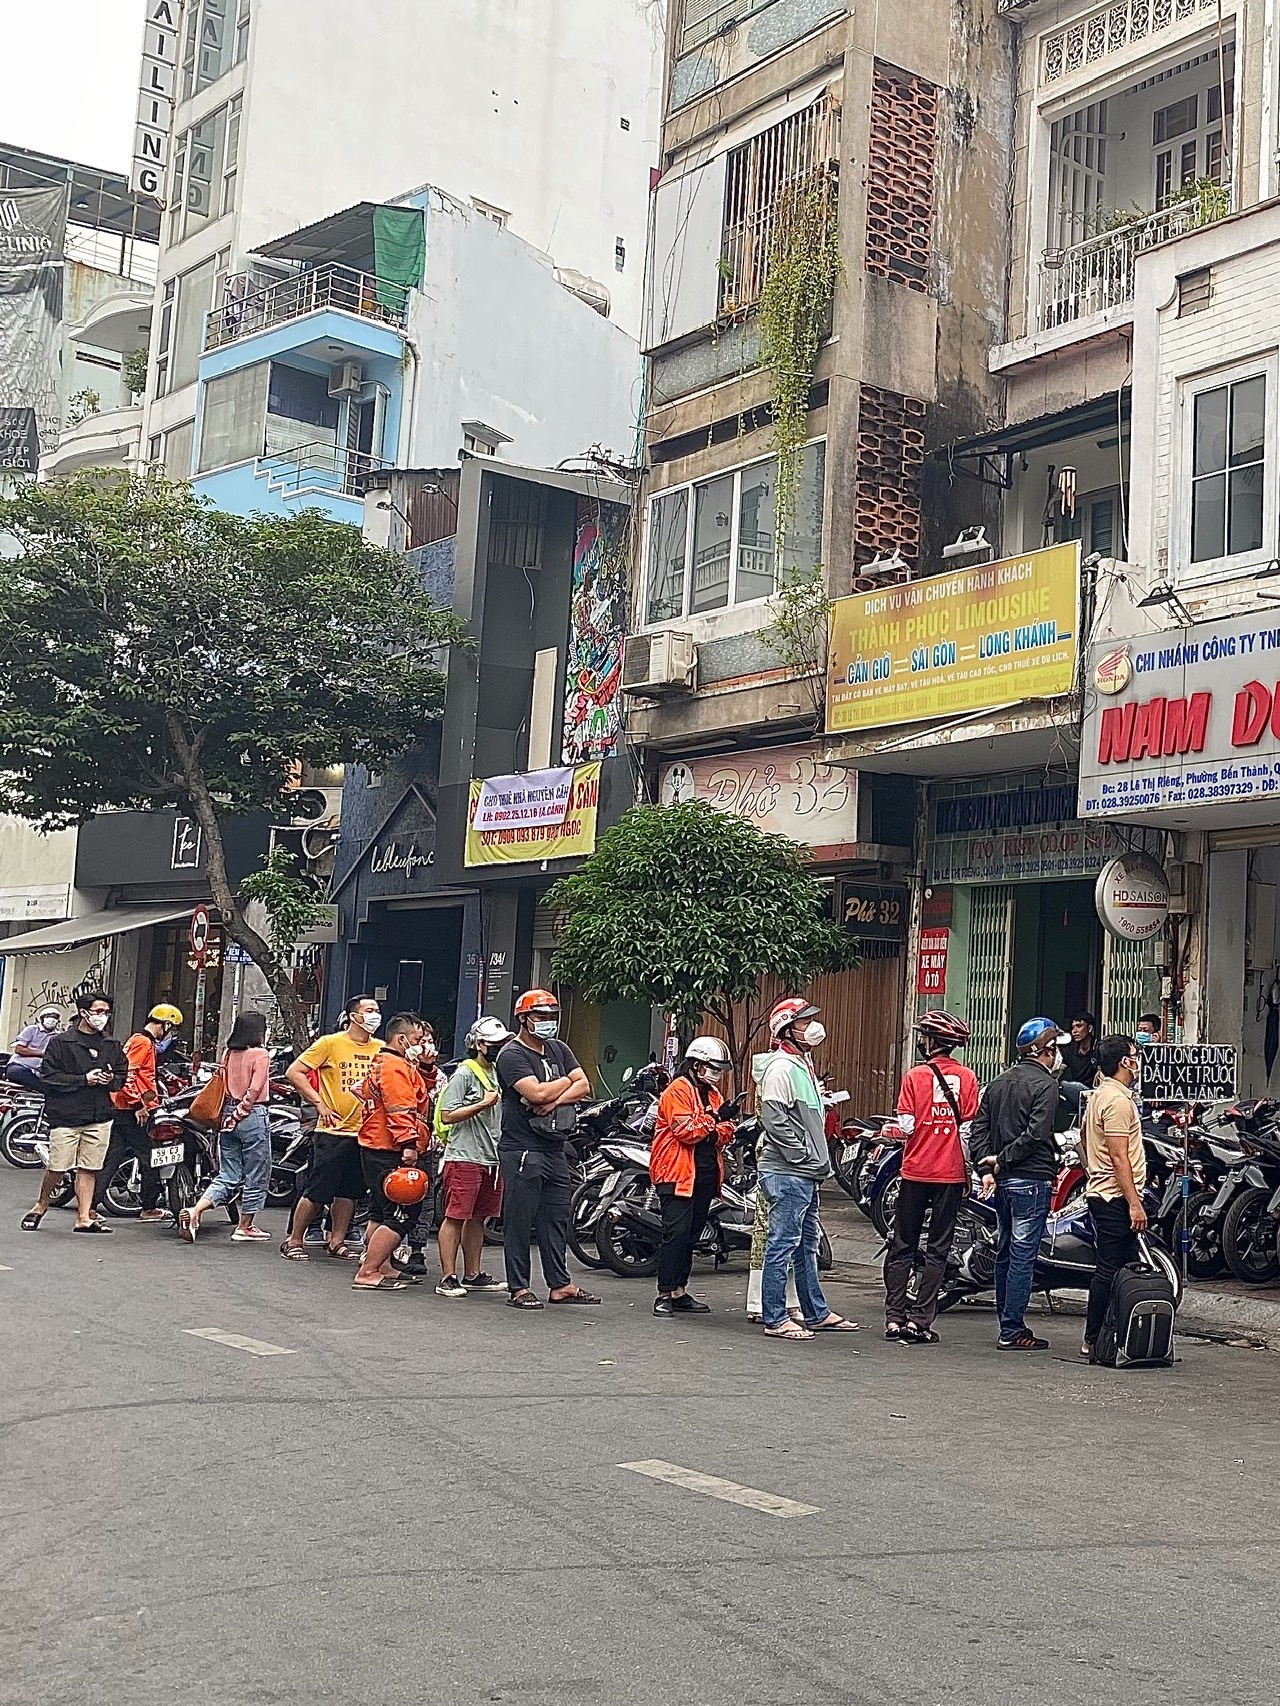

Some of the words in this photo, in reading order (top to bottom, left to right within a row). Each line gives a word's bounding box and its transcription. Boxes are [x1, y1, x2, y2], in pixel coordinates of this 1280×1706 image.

[864, 598, 887, 619] DỊCH
[889, 596, 902, 613] VỤ
[904, 588, 924, 611] VẬN
[926, 574, 964, 603] CHUYỂN
[967, 569, 995, 593] HÀNH
[997, 562, 1033, 586] KHÁCH
[849, 620, 900, 653] THÀNH
[905, 607, 951, 642] PHÚC
[955, 587, 1051, 632] LIMOUSINE
[847, 656, 869, 686] CẦN
[872, 651, 892, 681] GIỜ
[910, 643, 930, 674] SÀI
[933, 637, 957, 670] GÒN
[979, 629, 1011, 661] LONG
[1013, 618, 1057, 653] KHÁNH
[1135, 651, 1155, 674] CHI
[1158, 638, 1199, 670] NHÁNH
[1202, 635, 1236, 661] CÔNG
[1239, 633, 1256, 655] TY
[1097, 672, 1127, 685] HONDA
[1097, 691, 1213, 766] NAM
[706, 764, 781, 818] Phở
[1117, 781, 1129, 793] 28
[1130, 779, 1141, 791] Lê
[1141, 777, 1155, 793] Thị
[1157, 775, 1184, 789] Riêng,
[1186, 768, 1219, 786] Phường
[1221, 764, 1239, 780] Bến
[1086, 798, 1100, 811] ĐT:
[1101, 791, 1161, 809] 028.39250076
[1168, 789, 1186, 802] Fax:
[1188, 780, 1254, 800] 028.38397329
[845, 896, 877, 922] Phở
[879, 900, 900, 925] 32
[1118, 916, 1135, 933] 1900
[921, 955, 930, 969] XE
[930, 951, 946, 969] MÁY
[1142, 1046, 1167, 1064] VUI
[1175, 1066, 1193, 1084] XE
